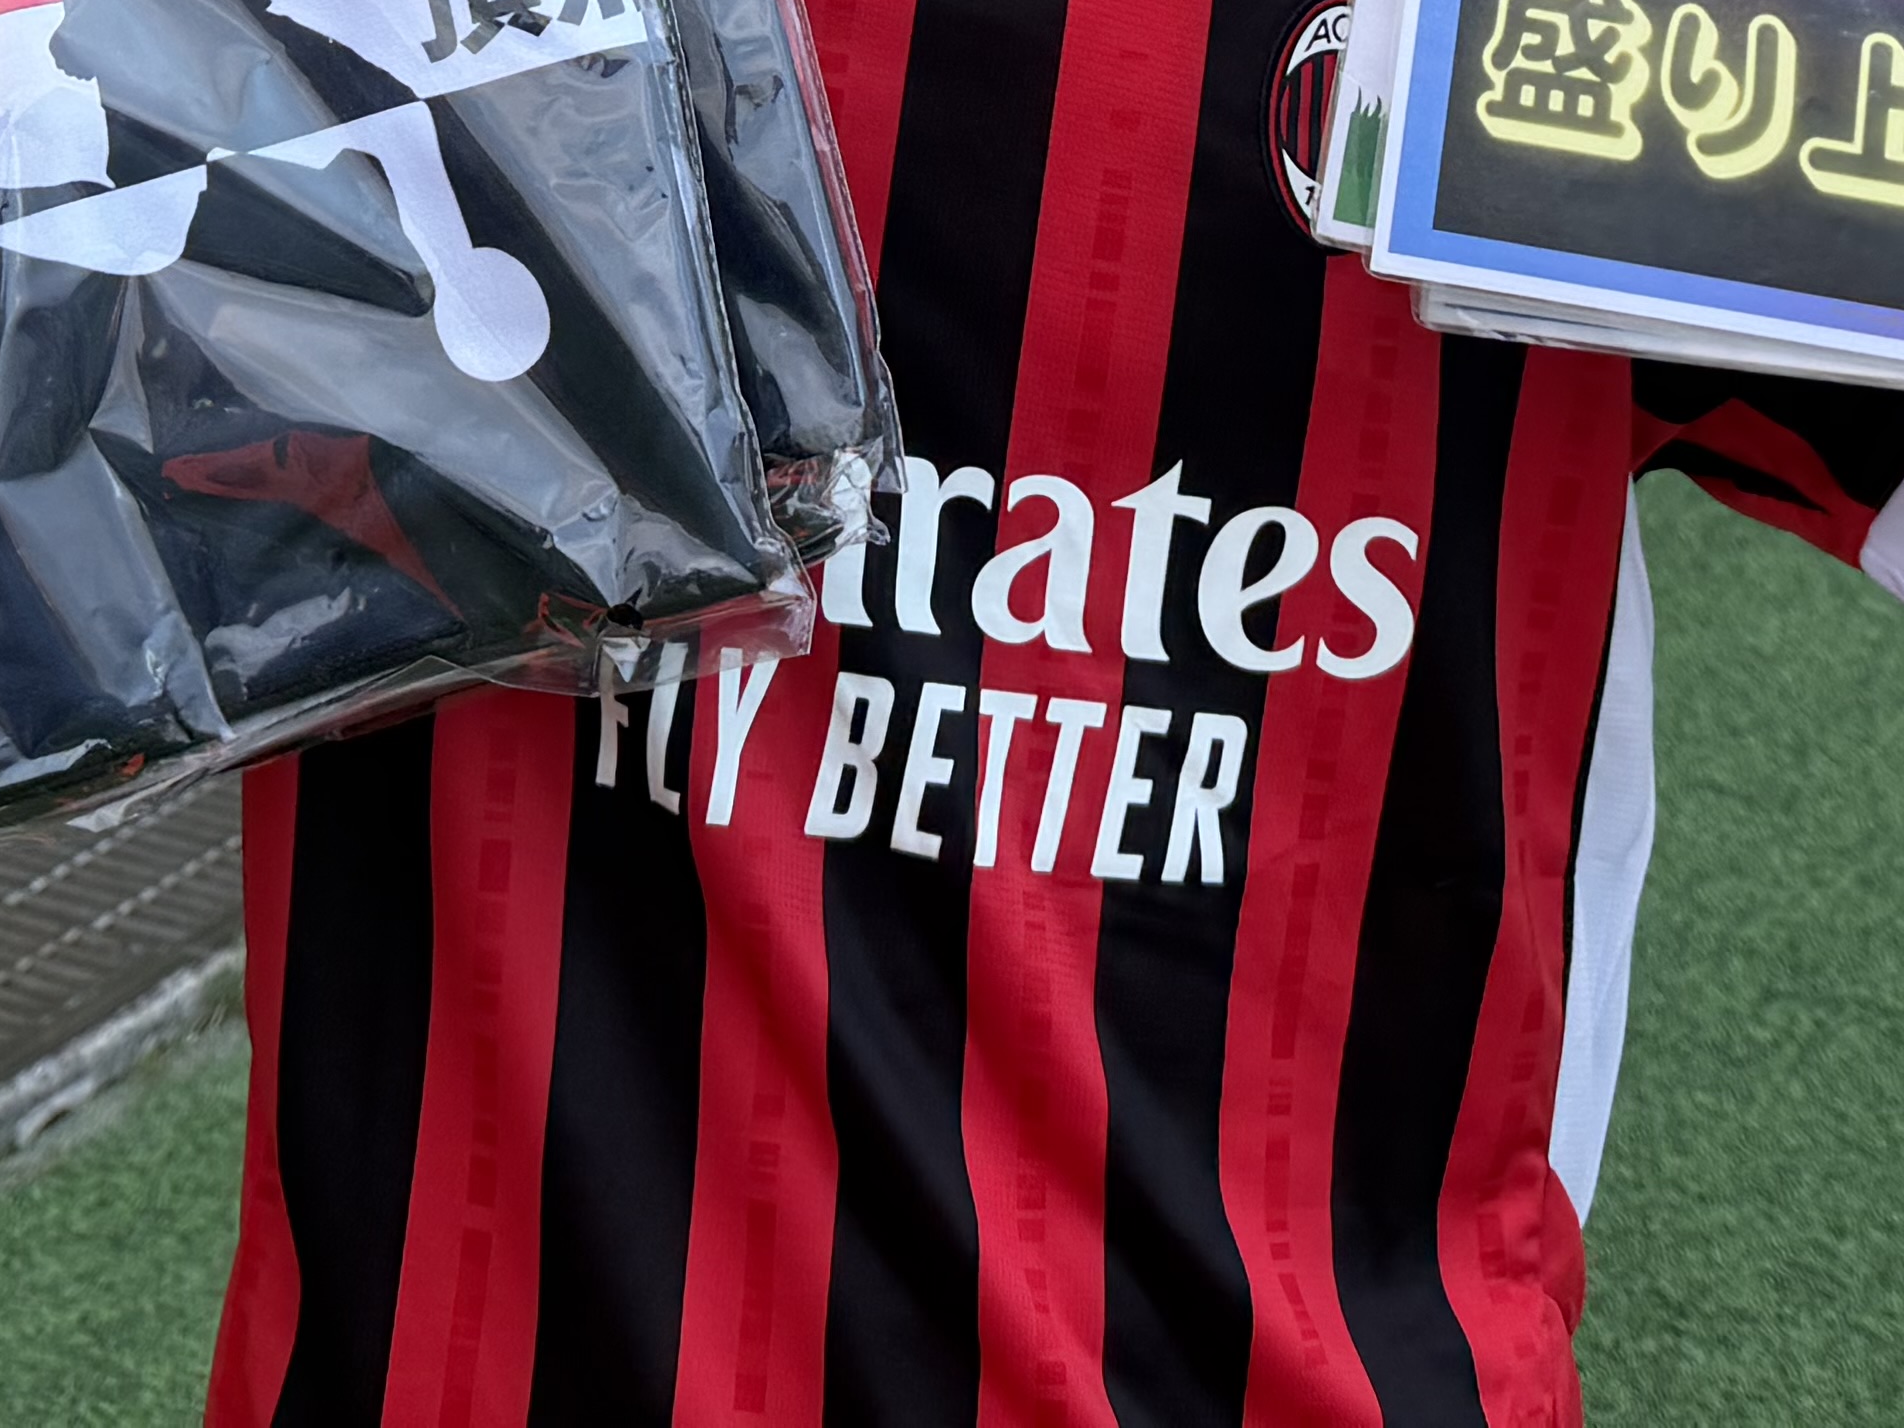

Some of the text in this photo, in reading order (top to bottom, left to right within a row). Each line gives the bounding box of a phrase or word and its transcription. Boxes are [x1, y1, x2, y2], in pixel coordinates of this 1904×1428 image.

[1304, 13, 1349, 53] AC
[596, 641, 1249, 885] FLY BETTER
